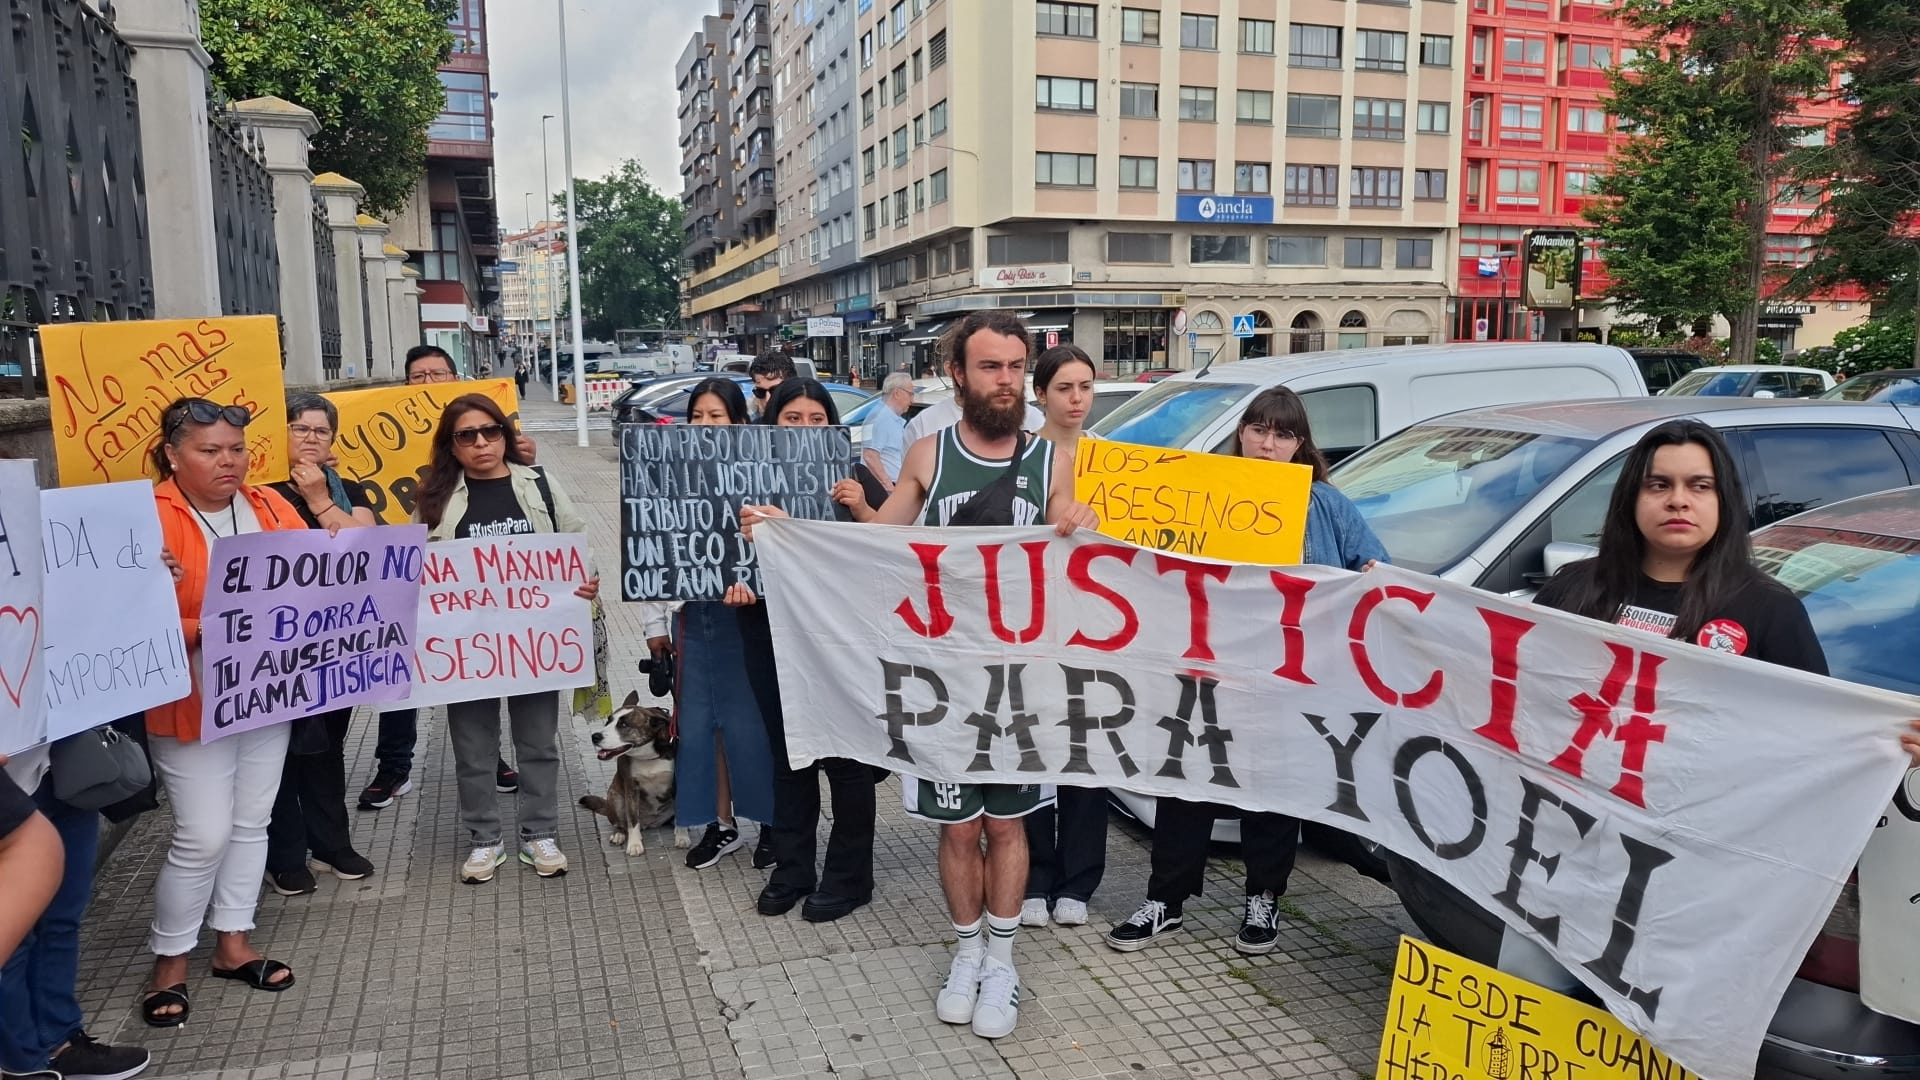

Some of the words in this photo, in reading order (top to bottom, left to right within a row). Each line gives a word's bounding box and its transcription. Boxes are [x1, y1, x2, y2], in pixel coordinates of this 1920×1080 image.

[1216, 199, 1253, 214] ancla
[1531, 235, 1575, 247] Alhambra
[1795, 306, 1811, 314] MAR
[55, 328, 125, 438] No
[140, 320, 228, 380] mas
[336, 390, 450, 481] YOEL
[622, 428, 672, 461] CADA
[677, 430, 731, 461] PASO
[738, 428, 780, 463] QUE
[785, 428, 850, 462] DAMOS
[621, 463, 678, 496] HACIA
[683, 463, 709, 497] LA
[714, 461, 790, 496] JUSTICIA
[794, 463, 819, 495] ES
[624, 499, 714, 532] TRIBUTO
[721, 502, 739, 530] A
[1087, 481, 1283, 536] ASESINOS
[117, 528, 147, 570] de
[473, 541, 588, 584] MÁXIMA
[627, 535, 666, 567] UN
[671, 532, 725, 567] ECO
[734, 533, 759, 566] D
[1124, 528, 1208, 555] ANDAN
[222, 556, 253, 593] EL
[262, 551, 370, 591] DOLOR
[380, 545, 423, 582] NO
[624, 568, 672, 599] QUE
[219, 608, 253, 644] TE
[267, 594, 381, 643] BORRA
[429, 587, 498, 614] PARA
[507, 586, 550, 610] LOS
[212, 656, 241, 698] TU
[895, 540, 1668, 809] JUSTICIA
[214, 672, 312, 729] CLAMA
[875, 656, 1241, 788] PARA
[935, 783, 962, 810] 92
[1302, 711, 1677, 1023] YOEL
[1397, 995, 1431, 1042] LA
[1398, 939, 1542, 1036] DESDE
[1575, 1018, 1689, 1080] CUAN
